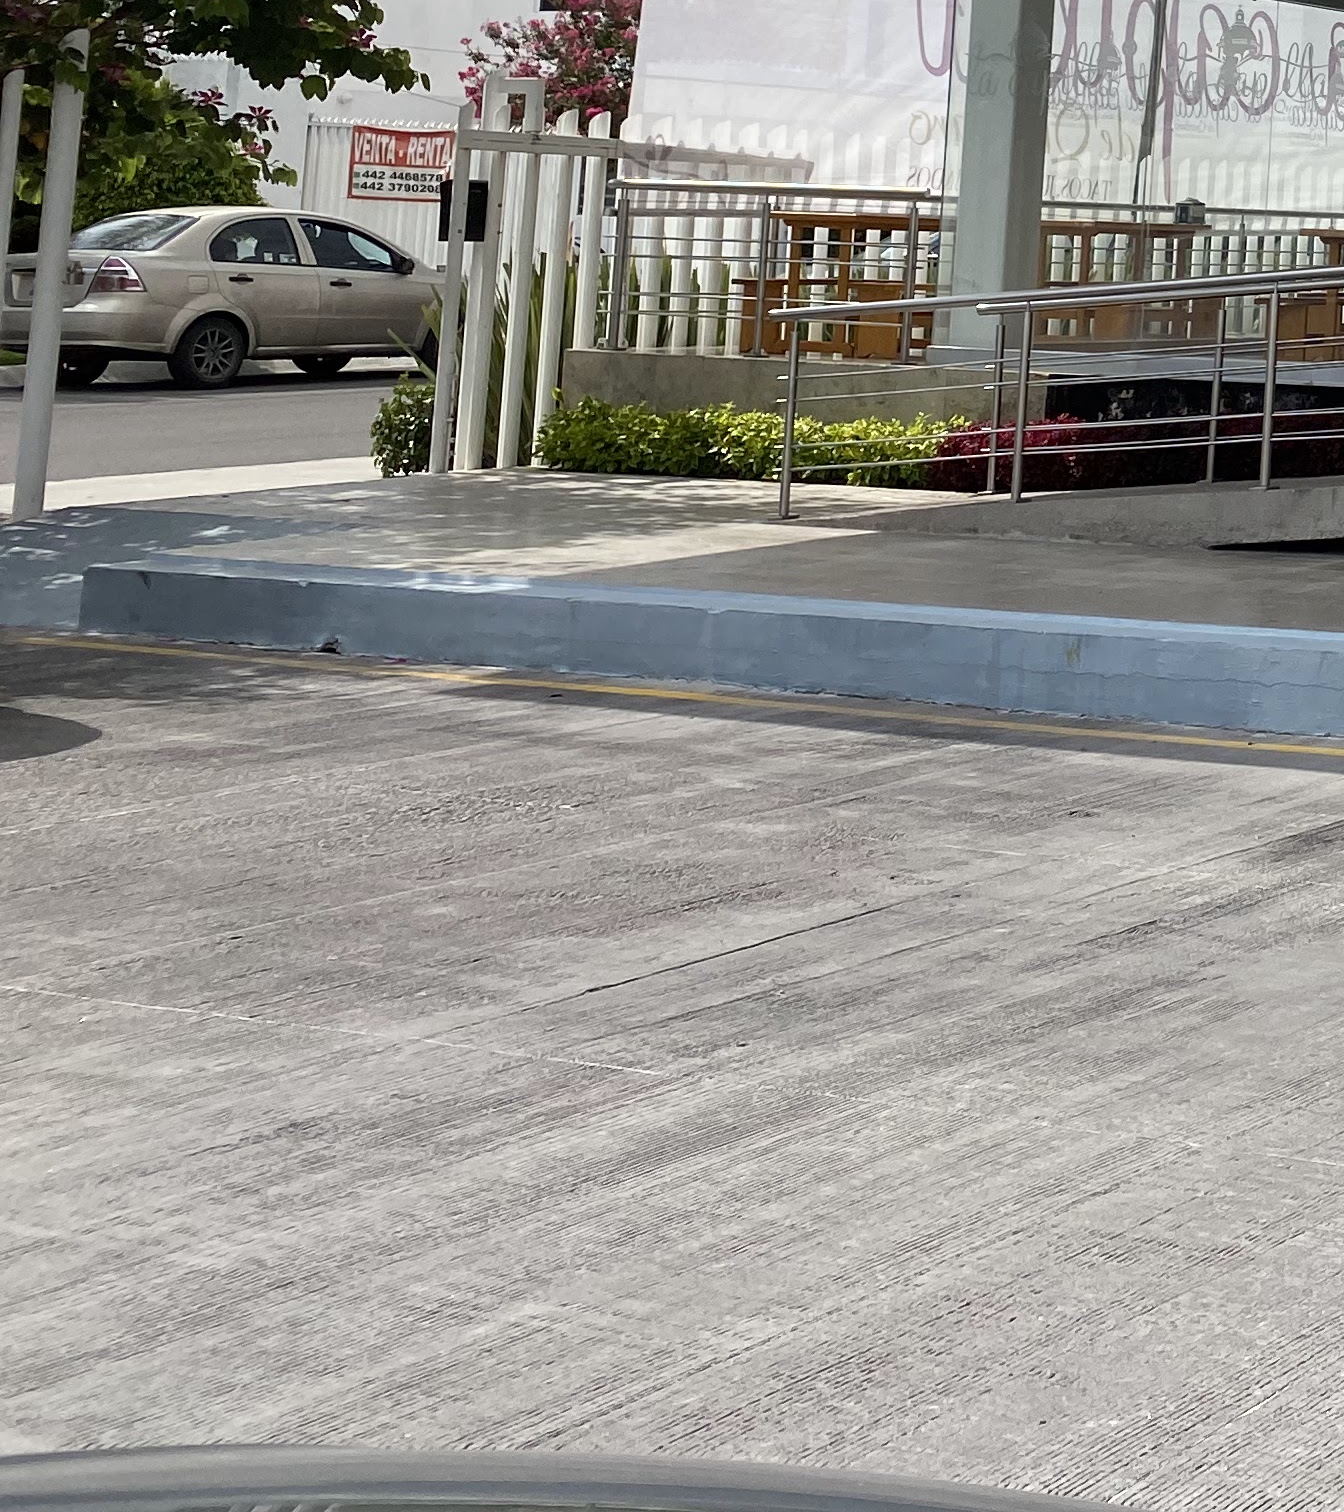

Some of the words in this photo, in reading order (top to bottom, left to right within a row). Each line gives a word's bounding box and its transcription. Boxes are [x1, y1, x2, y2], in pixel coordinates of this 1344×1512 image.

[355, 132, 396, 164] VENTA
[407, 136, 452, 166] RENTA
[361, 170, 386, 180] 442
[360, 181, 384, 191] 442
